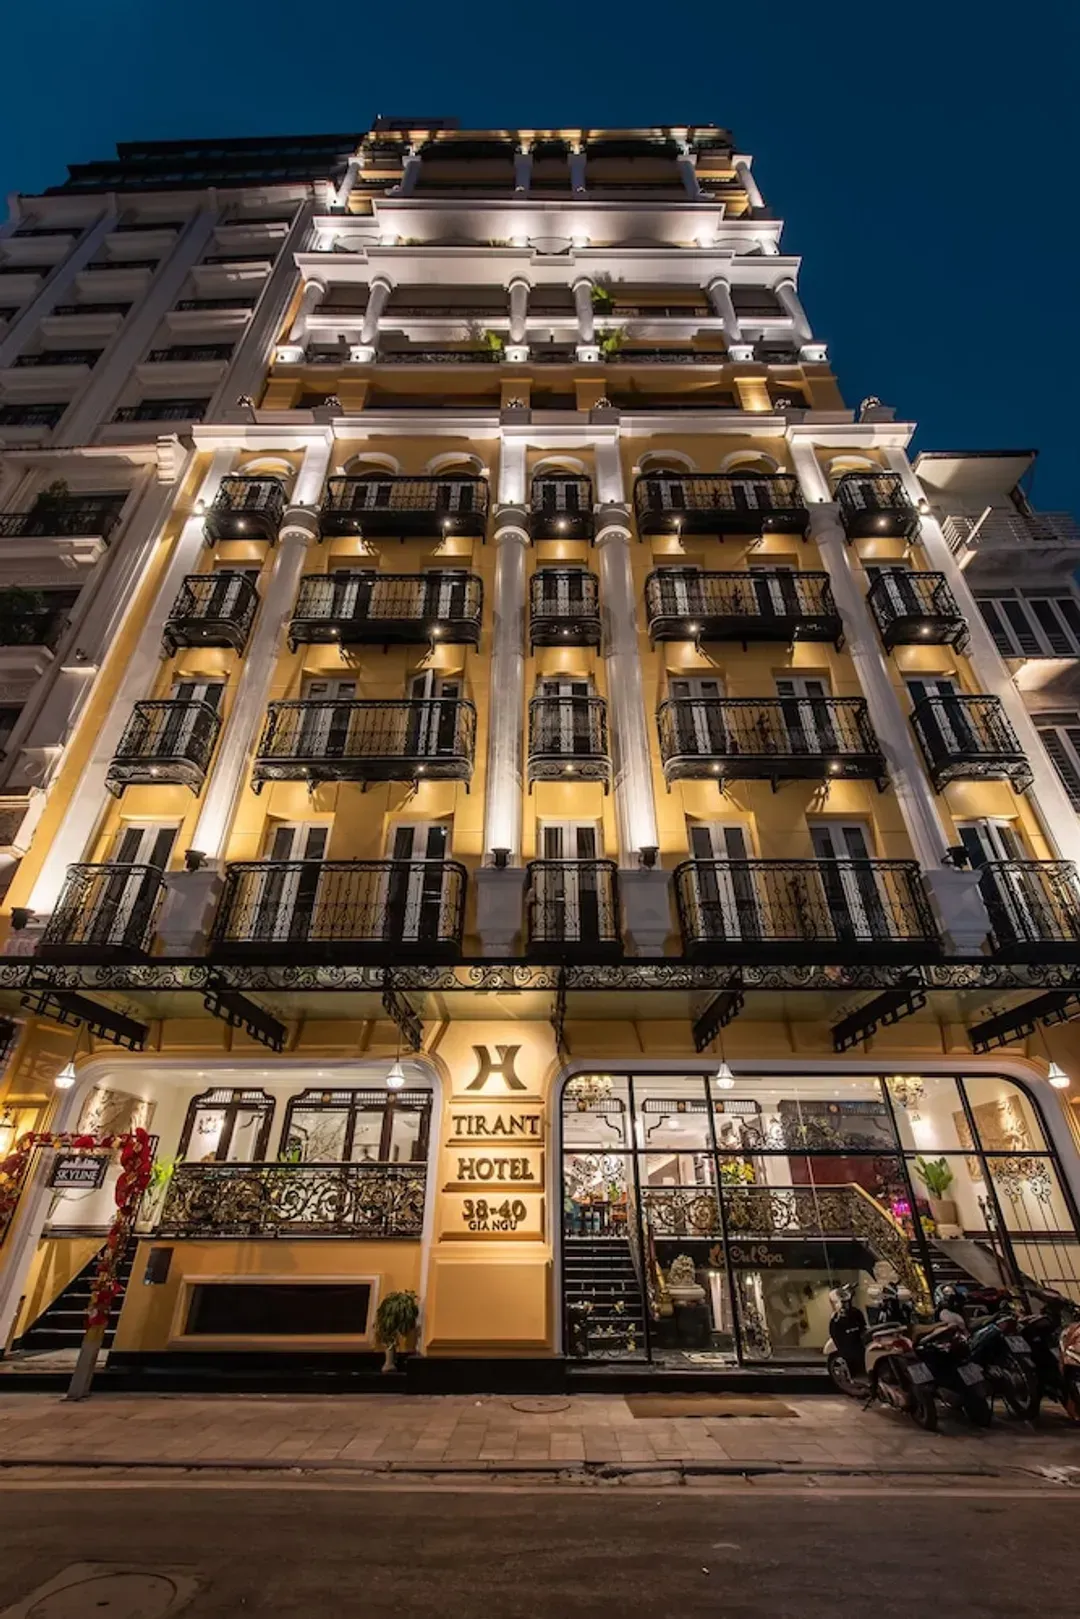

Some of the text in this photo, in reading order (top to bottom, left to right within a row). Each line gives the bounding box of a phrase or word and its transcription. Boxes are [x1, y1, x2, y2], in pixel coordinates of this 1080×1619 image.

[452, 1115, 540, 1135] TIRANT
[56, 1169, 99, 1180] SKYLINE
[457, 1158, 534, 1180] HOTEL
[462, 1199, 527, 1221] 38-40
[468, 1220, 490, 1231] GIA
[758, 1245, 784, 1267] Spa
